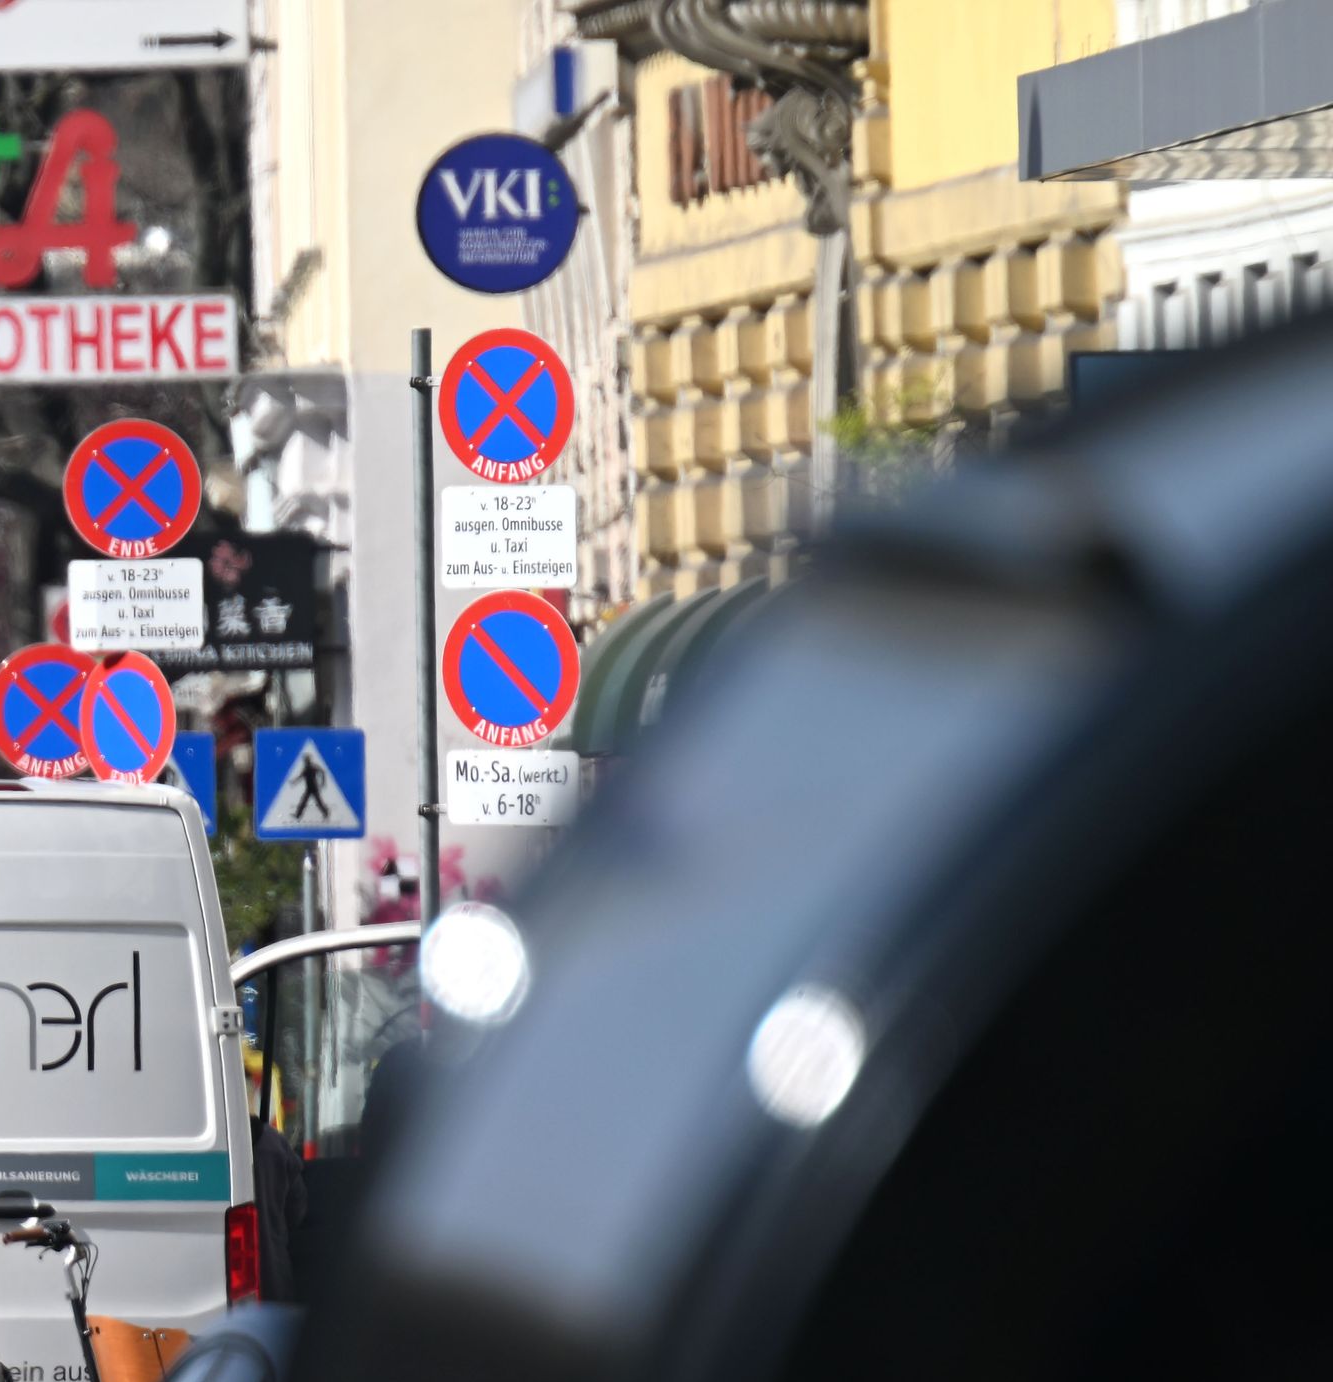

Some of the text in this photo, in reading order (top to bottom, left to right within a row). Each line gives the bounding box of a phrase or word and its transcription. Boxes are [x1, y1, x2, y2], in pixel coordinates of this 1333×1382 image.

[439, 168, 543, 220] VKI
[472, 452, 545, 481] ANFANG
[454, 516, 563, 535] ausgen. Omnibusse
[108, 536, 158, 557] ENDE
[490, 537, 528, 553] u. Taxi
[446, 563, 470, 575] zum
[473, 560, 498, 575] Aus-
[513, 559, 573, 577] Einsteigen
[82, 586, 190, 603] ausgen. Omnibusse
[118, 605, 155, 619] u. Taxi
[76, 627, 98, 639] zum
[101, 624, 126, 638] Aus-
[140, 623, 199, 640] Einsteigen
[473, 718, 549, 745] ANFANG
[15, 751, 87, 776] ANFANG
[125, 1168, 199, 1183] WÄSCHEREI
